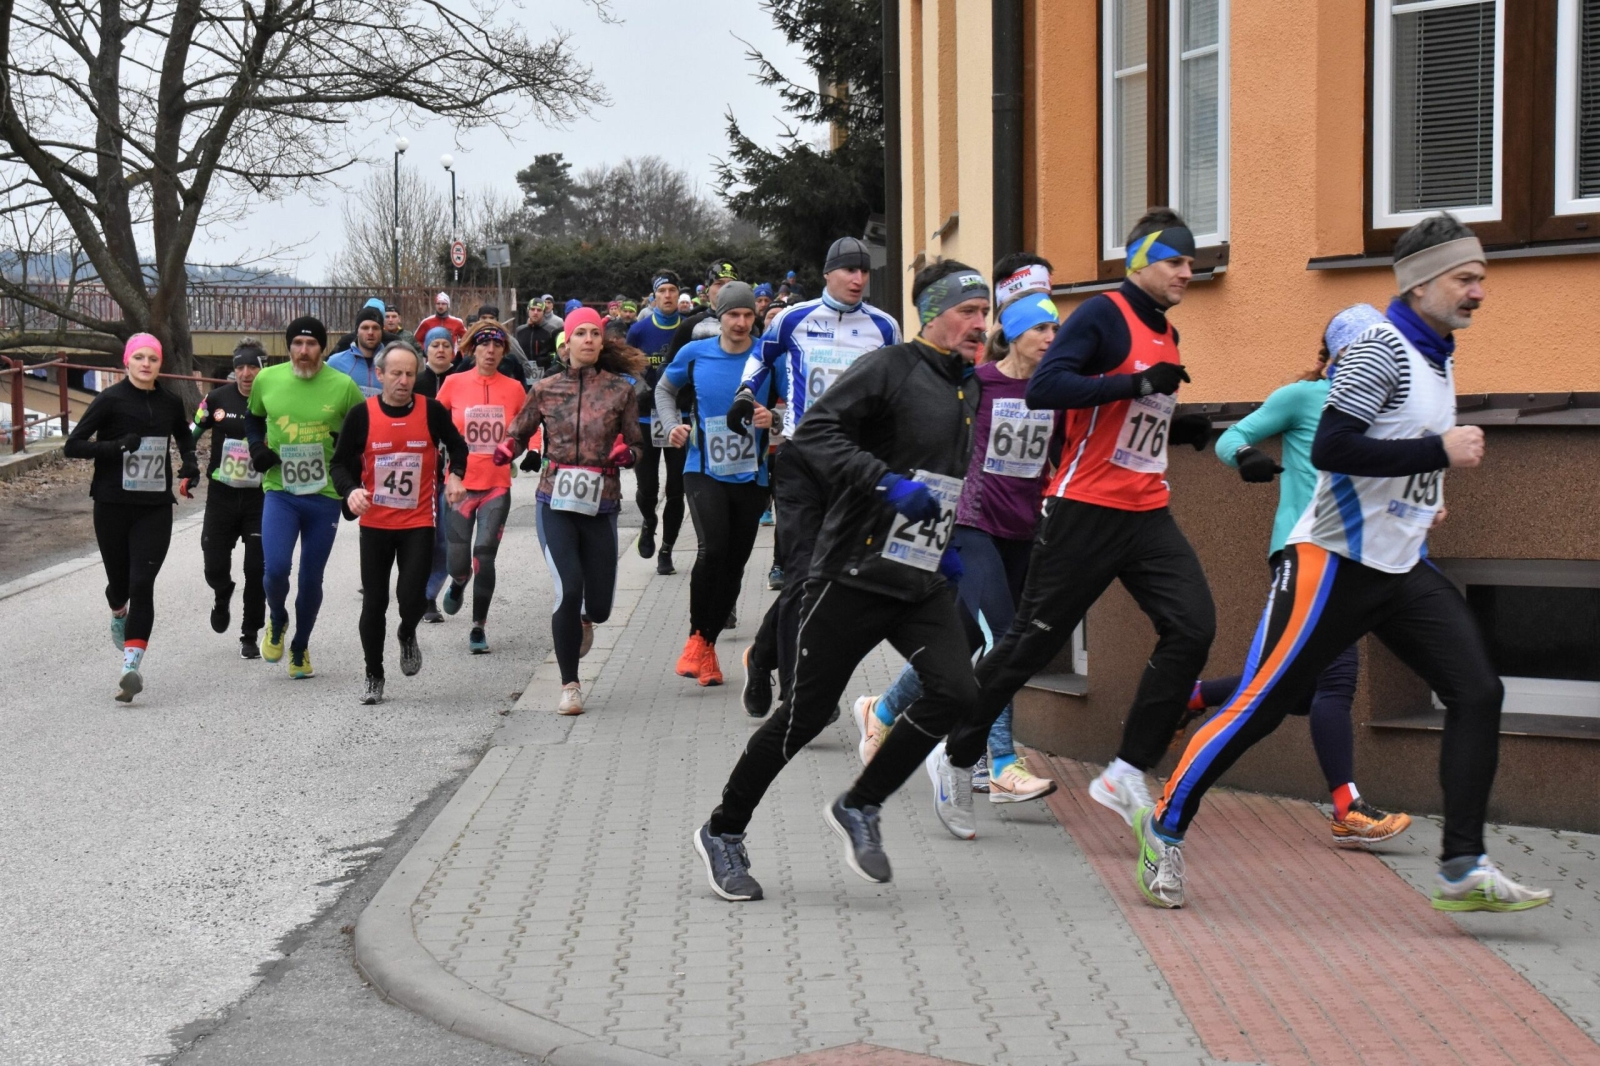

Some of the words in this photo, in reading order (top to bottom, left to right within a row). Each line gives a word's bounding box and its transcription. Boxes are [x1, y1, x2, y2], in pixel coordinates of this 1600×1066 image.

[994, 409, 1031, 419] BĚŽECKÁ
[1033, 412, 1050, 421] LIGA
[466, 421, 504, 443] 660
[993, 422, 1048, 459] 615
[1127, 412, 1167, 458] 176
[710, 433, 755, 463] 652
[125, 454, 165, 479] 672
[222, 454, 258, 479] 659
[283, 459, 325, 484] 663
[383, 470, 414, 497] 45
[557, 470, 601, 503] 661
